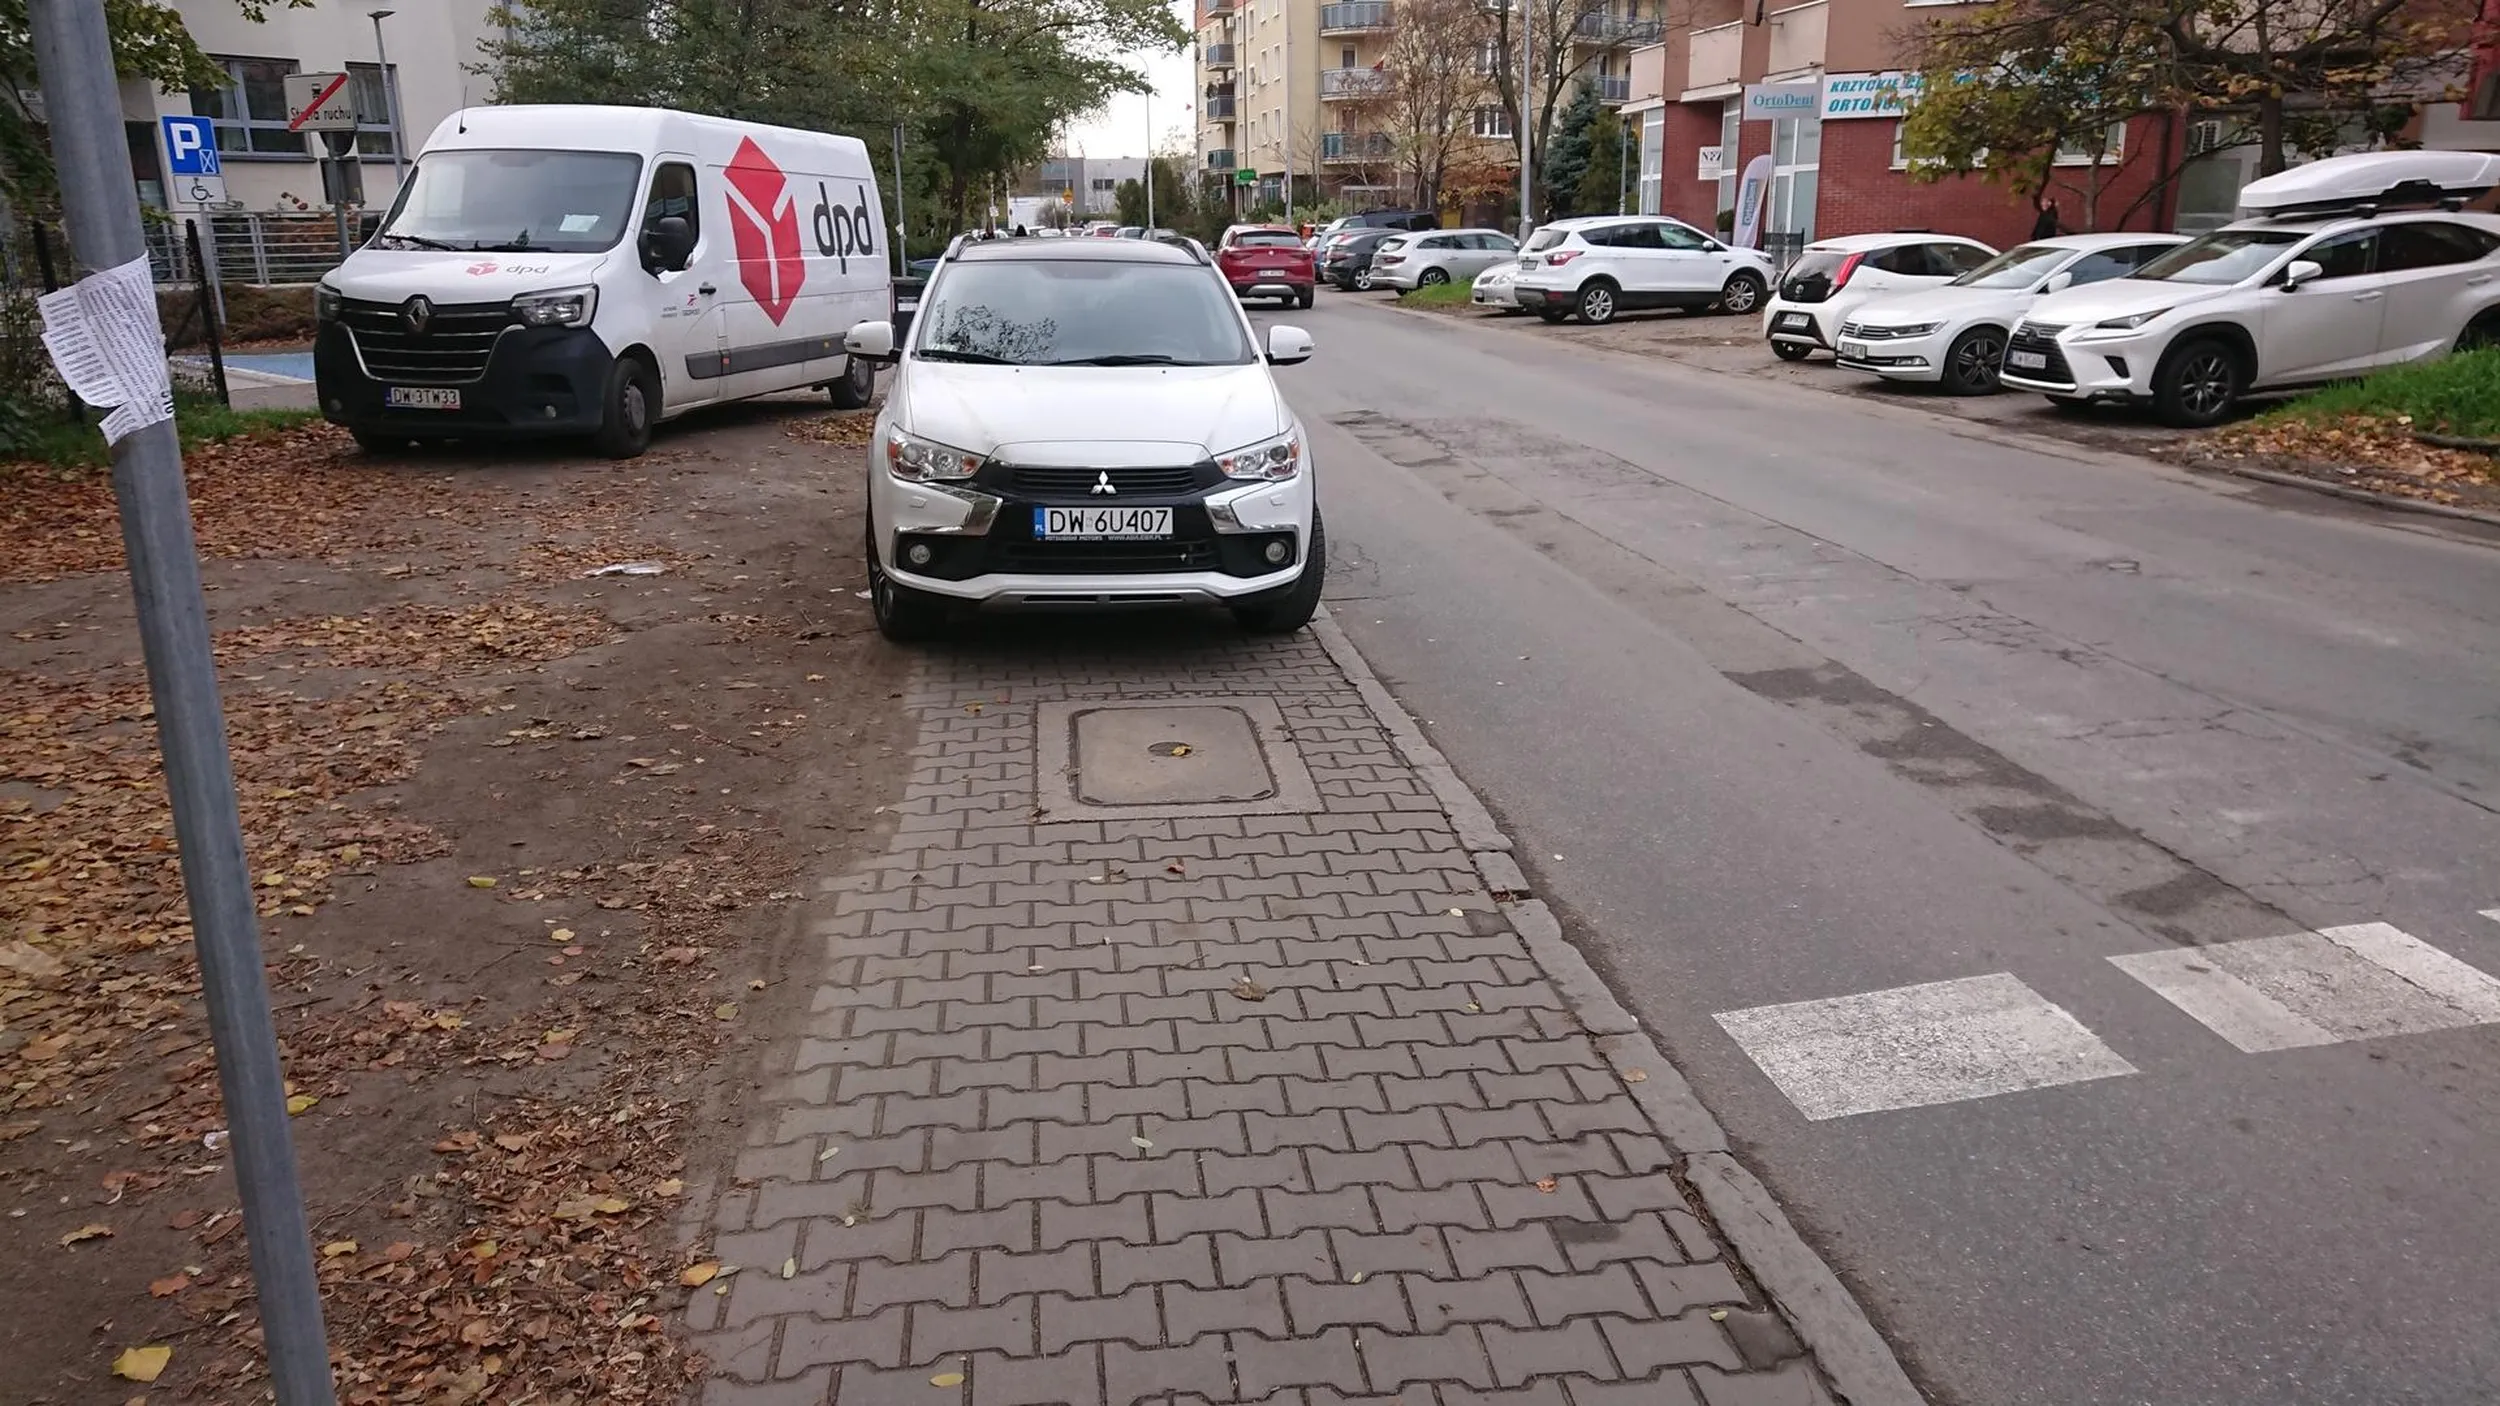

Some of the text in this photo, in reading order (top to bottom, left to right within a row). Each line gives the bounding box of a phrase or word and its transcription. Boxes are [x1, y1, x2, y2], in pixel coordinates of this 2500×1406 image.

[1753, 93, 1814, 106] OrtoDent
[324, 105, 351, 120] ruchu
[170, 122, 202, 160] P
[813, 181, 873, 275] dpd
[506, 264, 550, 275] dpd
[394, 388, 457, 404] DW 3TW33
[1050, 510, 1168, 533] DW 6U407
